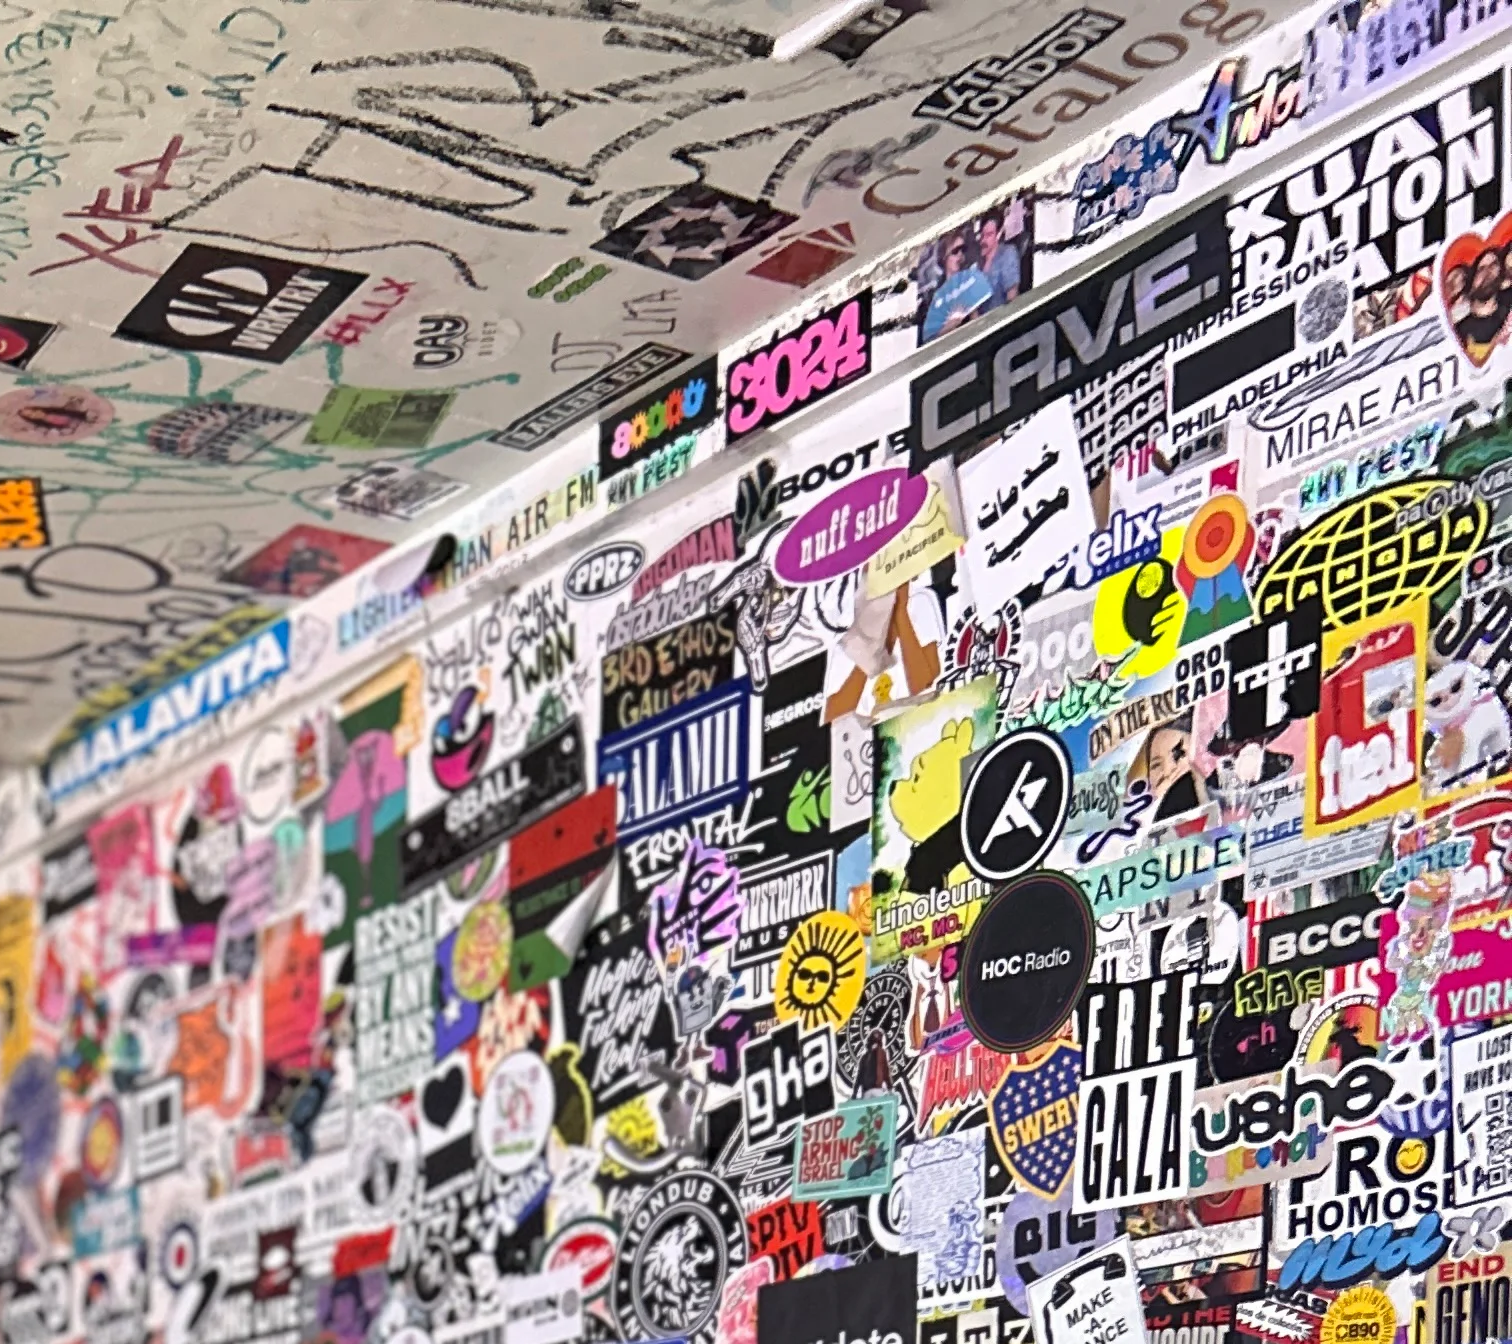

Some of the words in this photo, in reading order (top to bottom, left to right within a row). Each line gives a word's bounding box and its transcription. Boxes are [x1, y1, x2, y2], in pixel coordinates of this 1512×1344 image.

[956, 17, 1110, 125] LONDON
[1170, 242, 1349, 351] IMPRESSIONS
[728, 301, 868, 434] 3024
[916, 233, 1223, 452] C.A.V.E.
[1172, 343, 1349, 444] PHILADELPHIA
[1266, 387, 1382, 469] MIRAE
[1391, 356, 1461, 416] ART
[506, 502, 554, 545] AIR
[565, 472, 598, 514] FM
[799, 517, 850, 568] nuff
[855, 481, 902, 542] said
[574, 555, 635, 592] PPRZ
[638, 516, 736, 594] ARGOMAN
[894, 527, 946, 569] PACIFIER
[612, 704, 744, 826] BALAMII
[874, 881, 993, 934] Linoleum
[1079, 837, 1234, 908] CAPSULE
[932, 913, 963, 941] MO.
[981, 955, 1023, 980] HOC
[1024, 946, 1071, 971] Radio
[1090, 973, 1194, 1071] FREE
[802, 1136, 861, 1164] ARMING
[804, 1115, 846, 1144] STOP
[1085, 1071, 1184, 1206] GAZA
[800, 1159, 846, 1184] ISRAEL
[621, 1178, 715, 1265] LIONDUB
[1438, 1254, 1505, 1282] END
[1065, 1288, 1115, 1327] MAKE
